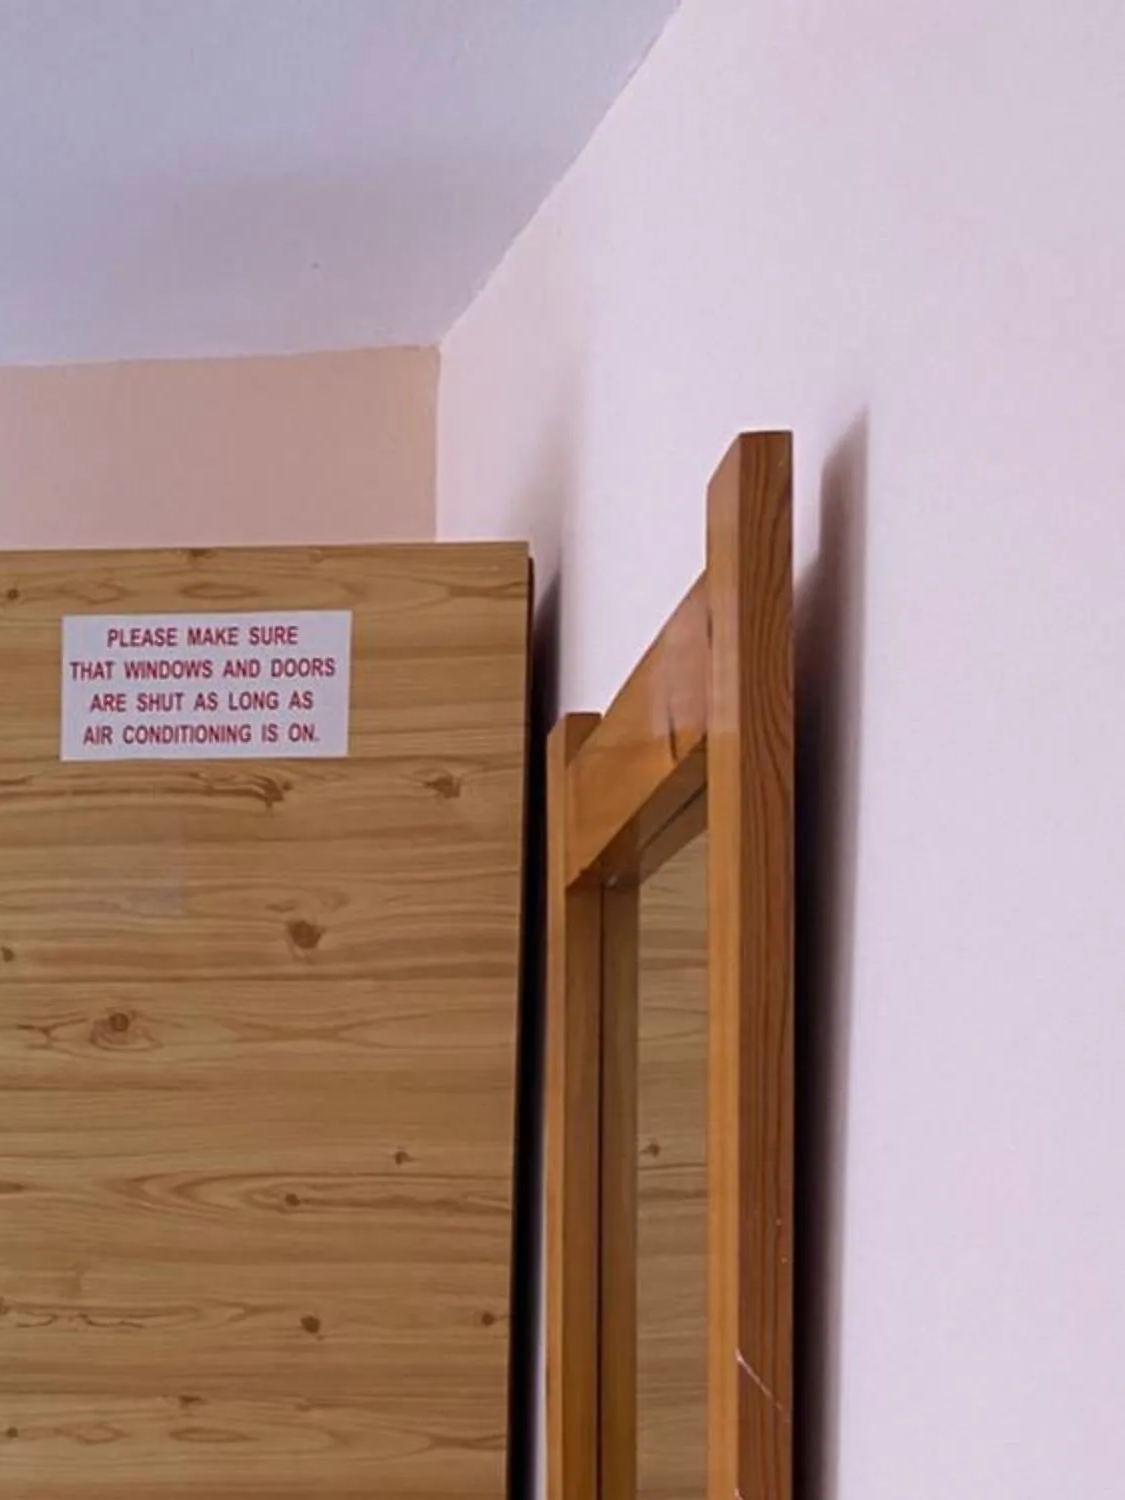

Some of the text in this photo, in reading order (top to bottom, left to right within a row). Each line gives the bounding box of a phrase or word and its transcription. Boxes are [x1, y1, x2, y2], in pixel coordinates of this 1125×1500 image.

[107, 626, 299, 648] PLEASE MAKE SURE
[69, 658, 336, 681] THAT WINDOWS AND DOORS
[90, 690, 314, 713] ARE SHUT AS LONG AS
[83, 723, 320, 745] AIR CONDITIONING IS ON.
